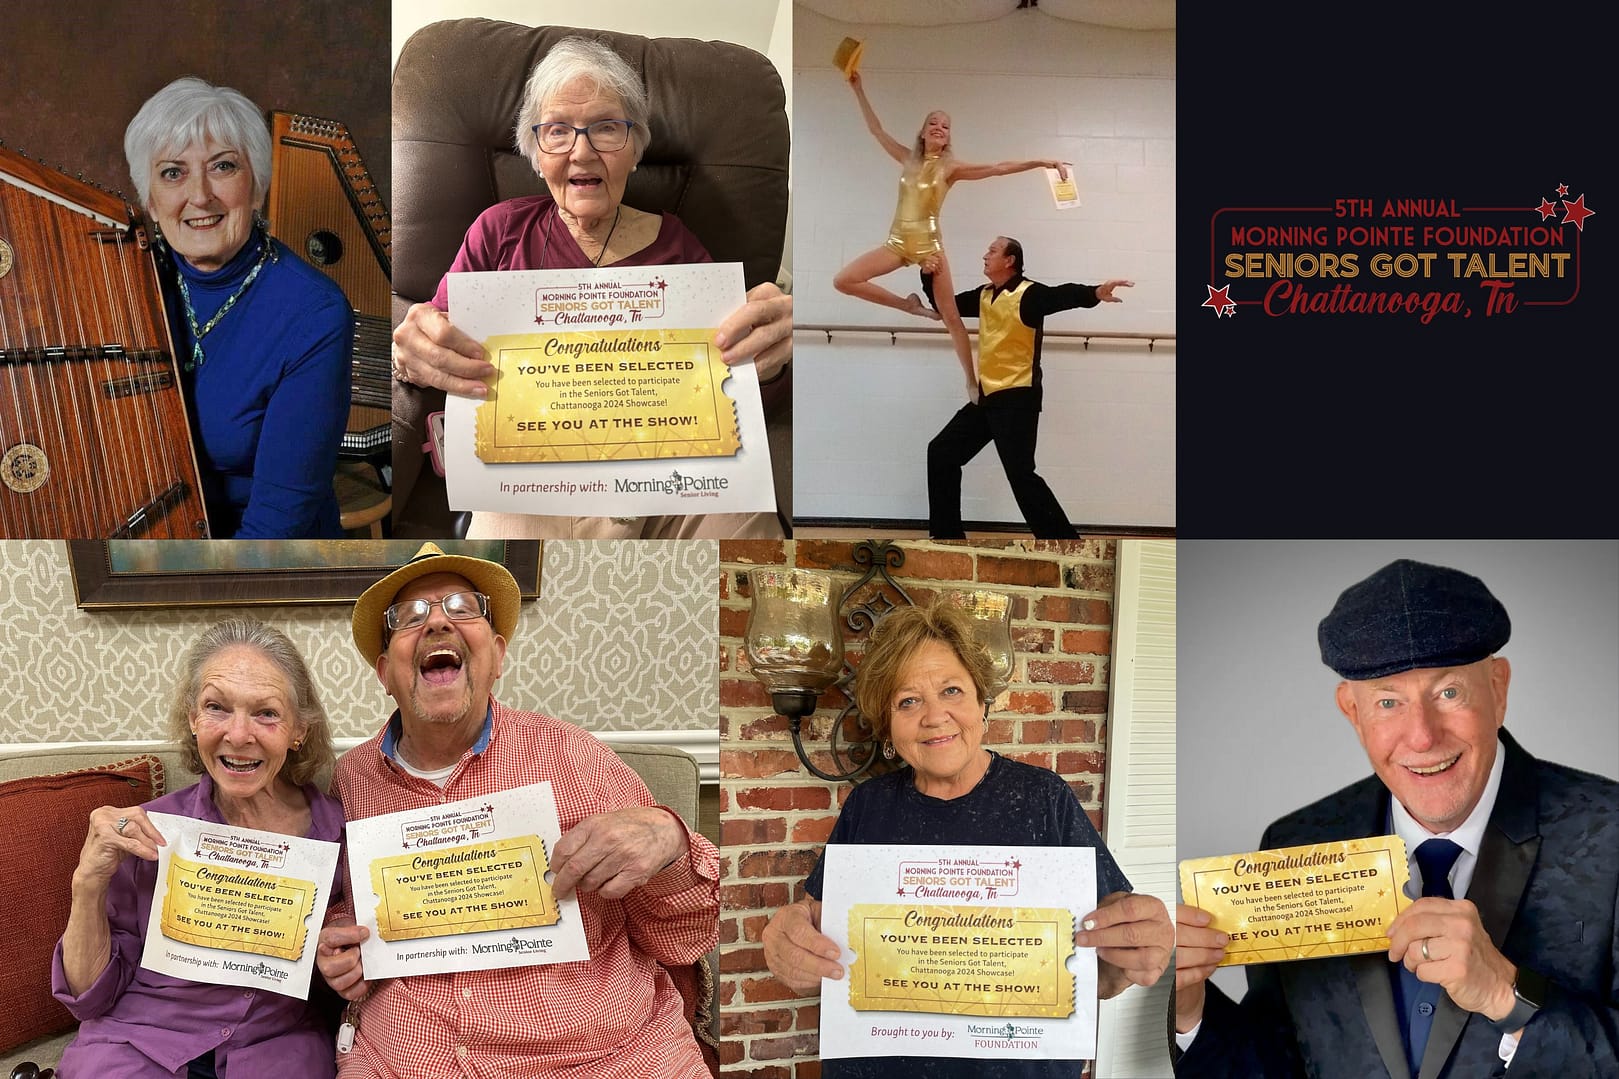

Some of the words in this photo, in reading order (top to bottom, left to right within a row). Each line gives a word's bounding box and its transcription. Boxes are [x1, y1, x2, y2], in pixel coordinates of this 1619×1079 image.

[609, 291, 658, 299] FOUNDATION
[541, 302, 587, 312] SENIORS
[591, 301, 614, 310] GOT
[618, 299, 661, 309] TALENT
[555, 312, 627, 326] Chattanooga,
[630, 310, 643, 322] Tn
[545, 338, 662, 359] Congratulations
[518, 365, 570, 375] YOU'VE
[576, 363, 614, 372] BEEN
[619, 362, 694, 371] SELECTED
[638, 377, 680, 386] participate
[584, 389, 614, 397] Seniors
[631, 388, 658, 396] Talent,
[551, 401, 601, 410] Chattanooga
[603, 400, 624, 408] 2024
[626, 399, 667, 407] Showcase!
[517, 421, 546, 431] SEE
[552, 420, 583, 430] YOU
[589, 419, 608, 429] AT
[613, 418, 643, 428] THE
[648, 416, 698, 426] SHOW!
[500, 482, 510, 492] In
[513, 481, 577, 496] partnership
[579, 480, 608, 492] with:
[615, 478, 672, 494] Morning
[683, 477, 728, 490] Pointe
[412, 849, 496, 870] Congratulations
[1234, 852, 1347, 877] Congratulations
[197, 867, 277, 891] Congratulations
[396, 874, 433, 884] YOU'VE
[436, 870, 463, 879] BEEN
[466, 861, 523, 874] SELECTED
[903, 877, 946, 885] SENIORS
[950, 877, 972, 886] GOT
[975, 878, 1015, 887] TALENT
[1212, 883, 1261, 896] YOU'VE
[1266, 878, 1301, 890] BEEN
[1306, 868, 1378, 885] SELECTED
[180, 880, 212, 892] YOU'VE
[215, 888, 241, 897] BEEN
[245, 892, 294, 905] SELECTED
[915, 886, 983, 902] Chattanooga,
[985, 887, 998, 899] Tn
[1231, 898, 1244, 906] You
[1246, 896, 1263, 904] have
[1284, 892, 1314, 900] selected
[1325, 885, 1365, 896] participate
[403, 911, 423, 920] SEE
[425, 909, 446, 917] YOU
[450, 907, 463, 915] AT
[466, 904, 488, 913] THE
[491, 899, 528, 910] SHOW!
[1276, 901, 1303, 910] Seniors
[1319, 897, 1344, 906] Talent,
[905, 910, 1014, 931] Congratulations
[1248, 913, 1294, 923] Chattanooga
[1295, 910, 1313, 918] 2024
[1315, 905, 1354, 916] Showcase!
[176, 914, 191, 924] SEE
[194, 919, 212, 928] YOU
[232, 926, 251, 934] THE
[253, 929, 285, 939] SHOW!
[1252, 929, 1279, 938] YOU
[1284, 927, 1301, 935] AT
[1305, 923, 1332, 933] THE
[1336, 918, 1382, 930] SHOW!
[472, 942, 512, 954] Morning
[519, 939, 553, 949] Pointe
[880, 935, 928, 944] YOU'VE
[973, 937, 1043, 946] SELECTED
[170, 953, 201, 968] partnership
[203, 959, 219, 968] with:
[397, 953, 404, 961] In
[405, 949, 447, 962] partnership
[448, 948, 468, 956] with:
[989, 951, 1028, 959] participate
[222, 961, 257, 975] Morning
[264, 967, 288, 979] Pointe
[911, 967, 955, 976] Chattanooga
[883, 979, 908, 987] SEE
[913, 981, 938, 989] YOU
[965, 984, 991, 992] THE
[995, 984, 1040, 993] SHOW!
[871, 1027, 908, 1039] Brought
[911, 1028, 920, 1036] to
[921, 1030, 939, 1039] you
[941, 1028, 955, 1040] by:
[968, 1025, 1005, 1035] Morning
[1015, 1027, 1043, 1035] Pointe
[975, 1040, 1038, 1049] FOUNDATION
